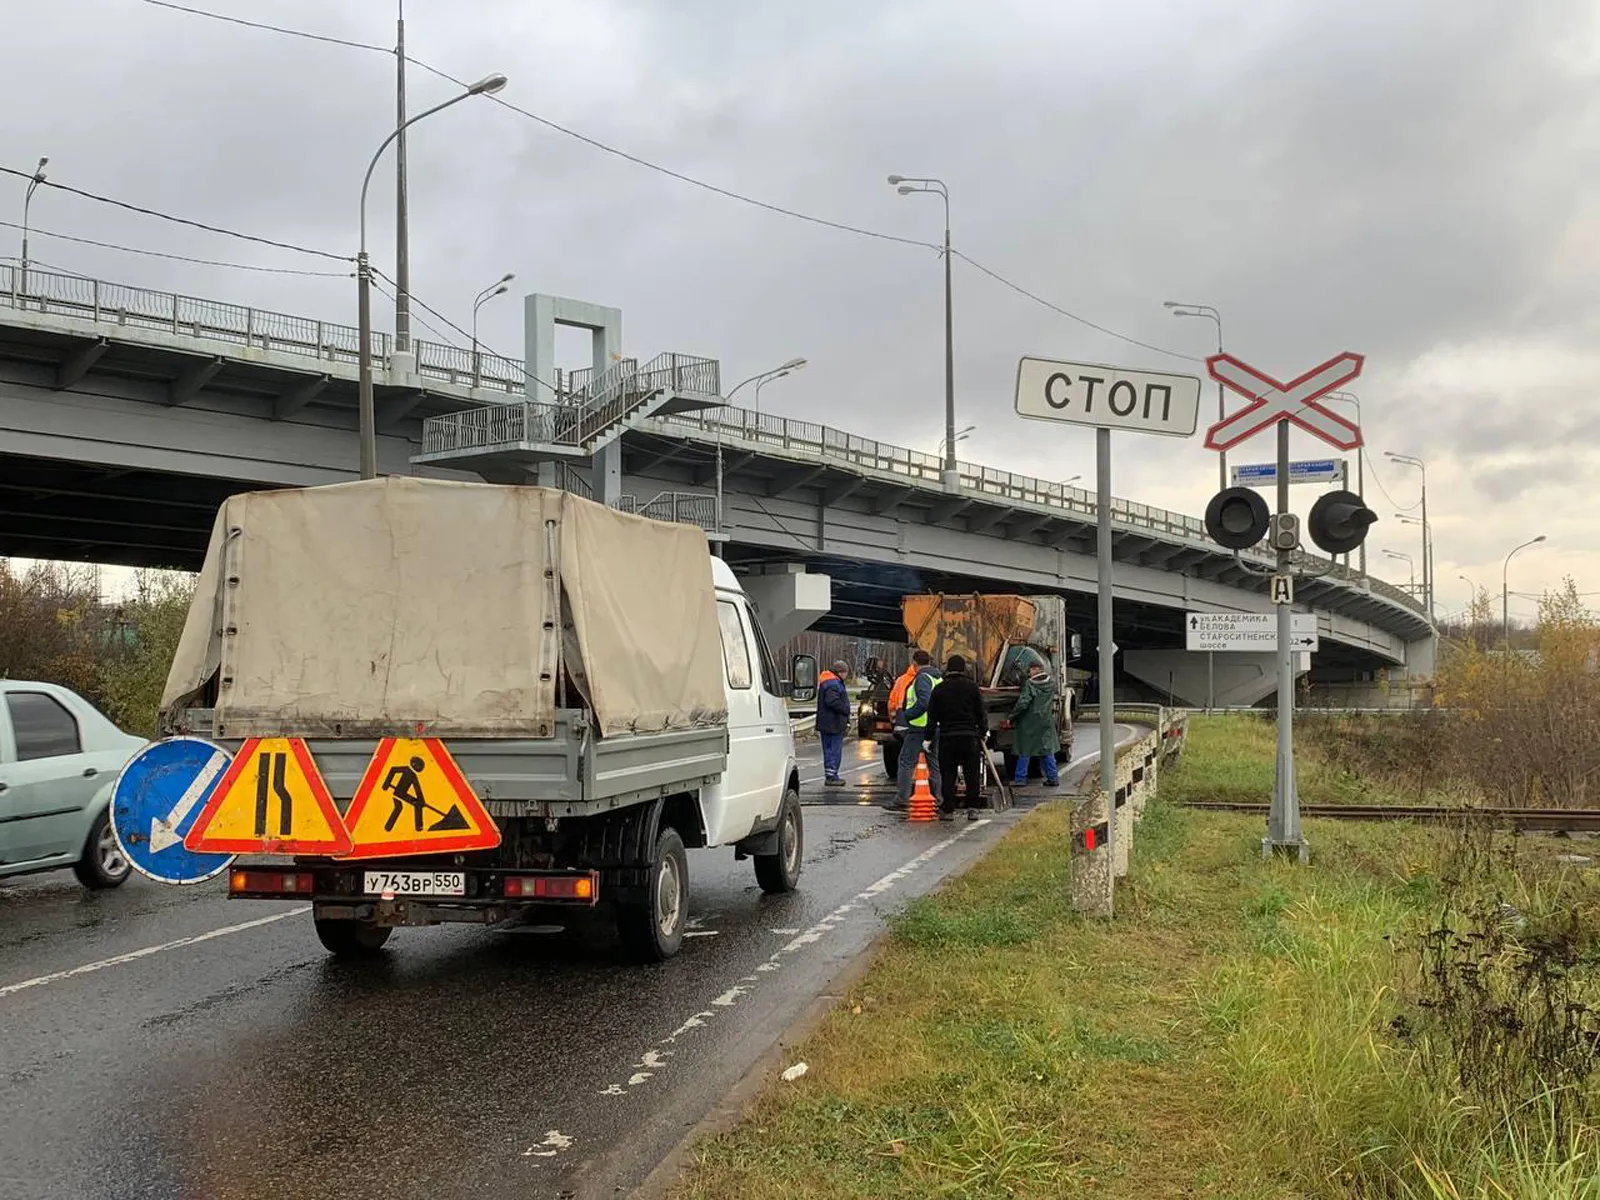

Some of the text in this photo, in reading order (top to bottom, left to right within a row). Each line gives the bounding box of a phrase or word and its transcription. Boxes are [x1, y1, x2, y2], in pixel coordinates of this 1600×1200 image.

[1045, 372, 1172, 421] СТОП
[1275, 578, 1290, 601] А
[1200, 623, 1236, 631] БЕЛОВА
[1200, 633, 1278, 641] СТАРОСИТНЕНСК
[435, 874, 460, 888] 550
